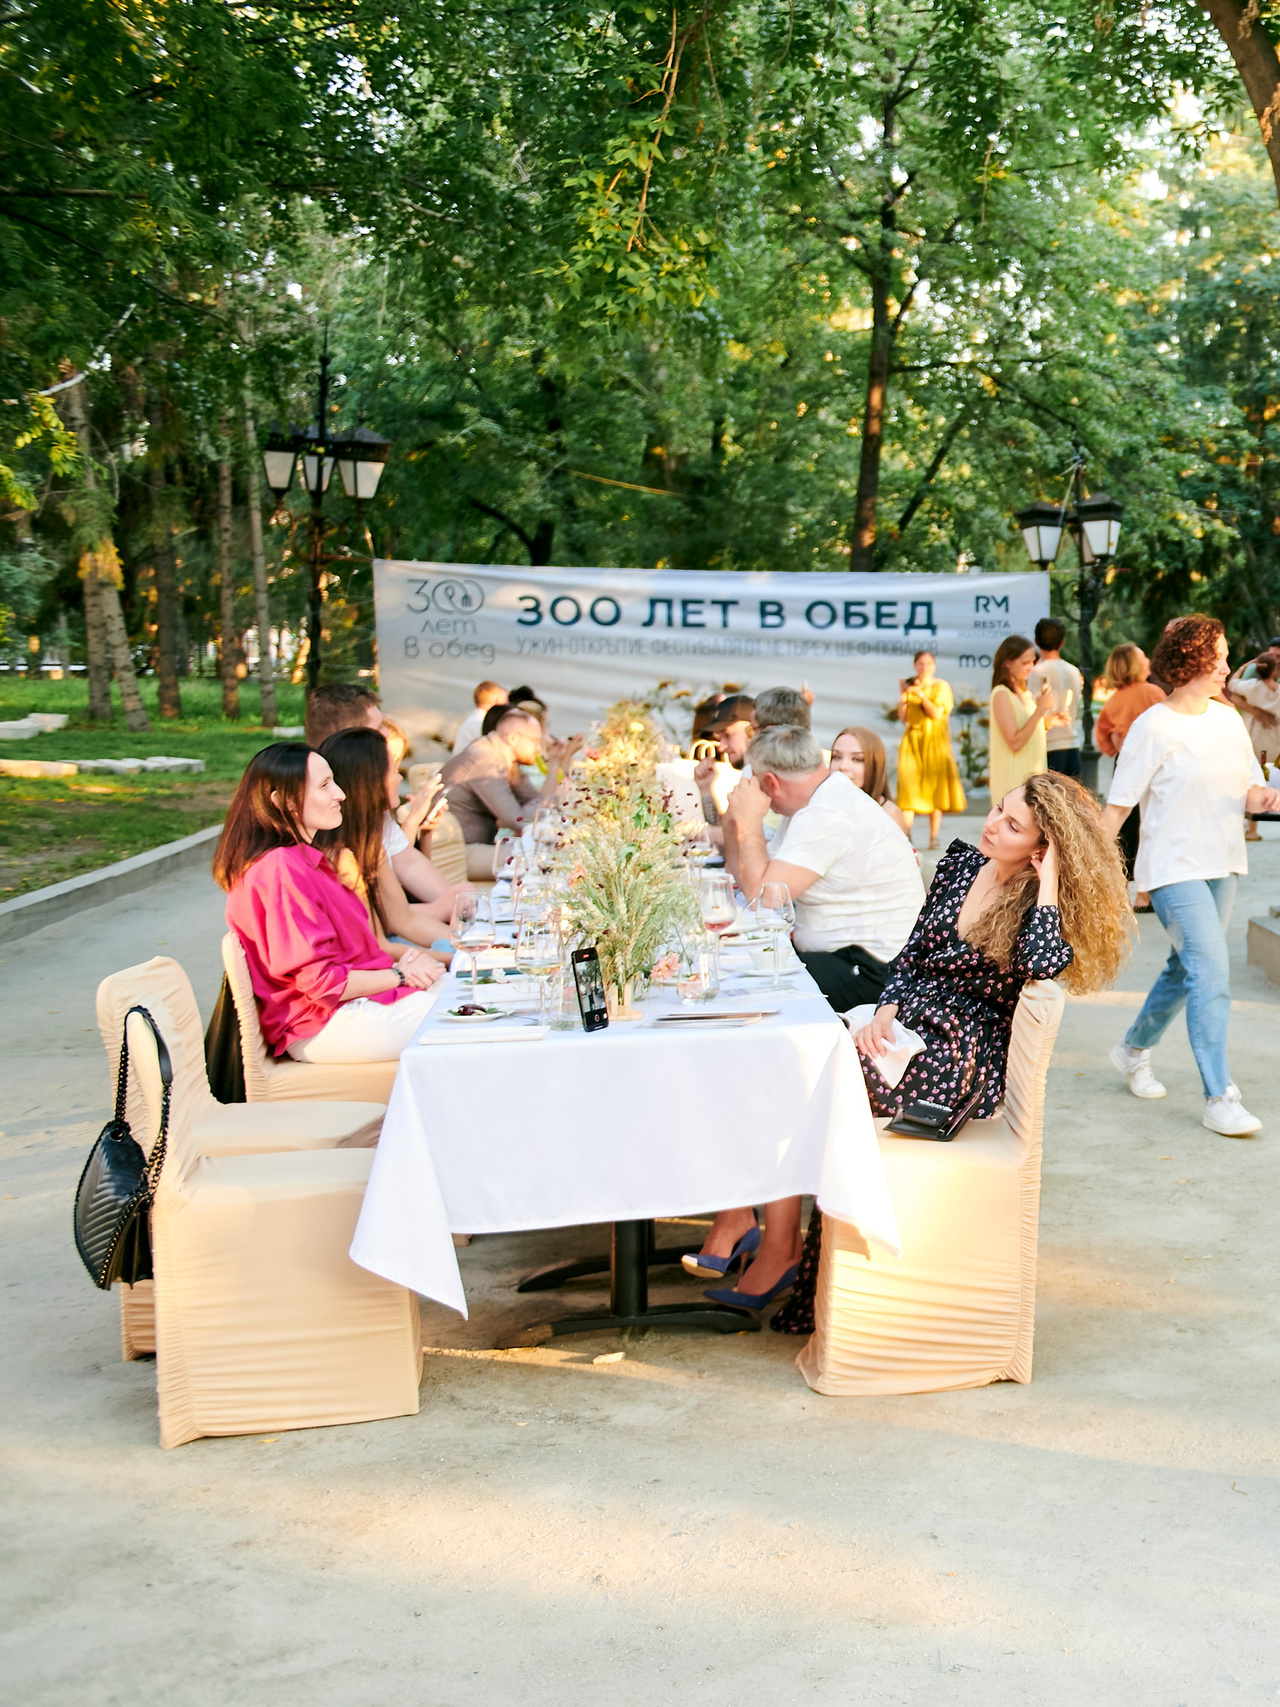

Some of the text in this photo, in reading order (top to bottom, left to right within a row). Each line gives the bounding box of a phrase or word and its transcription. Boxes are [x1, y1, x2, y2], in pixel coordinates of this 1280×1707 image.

[975, 594, 1009, 613] RM
[642, 598, 738, 628] ЛЕТ
[760, 600, 786, 629] В
[805, 600, 938, 636] ОБЕД
[974, 620, 1011, 628] RESTA
[516, 636, 648, 656] УЖИН-ОТКРЫТИЕ
